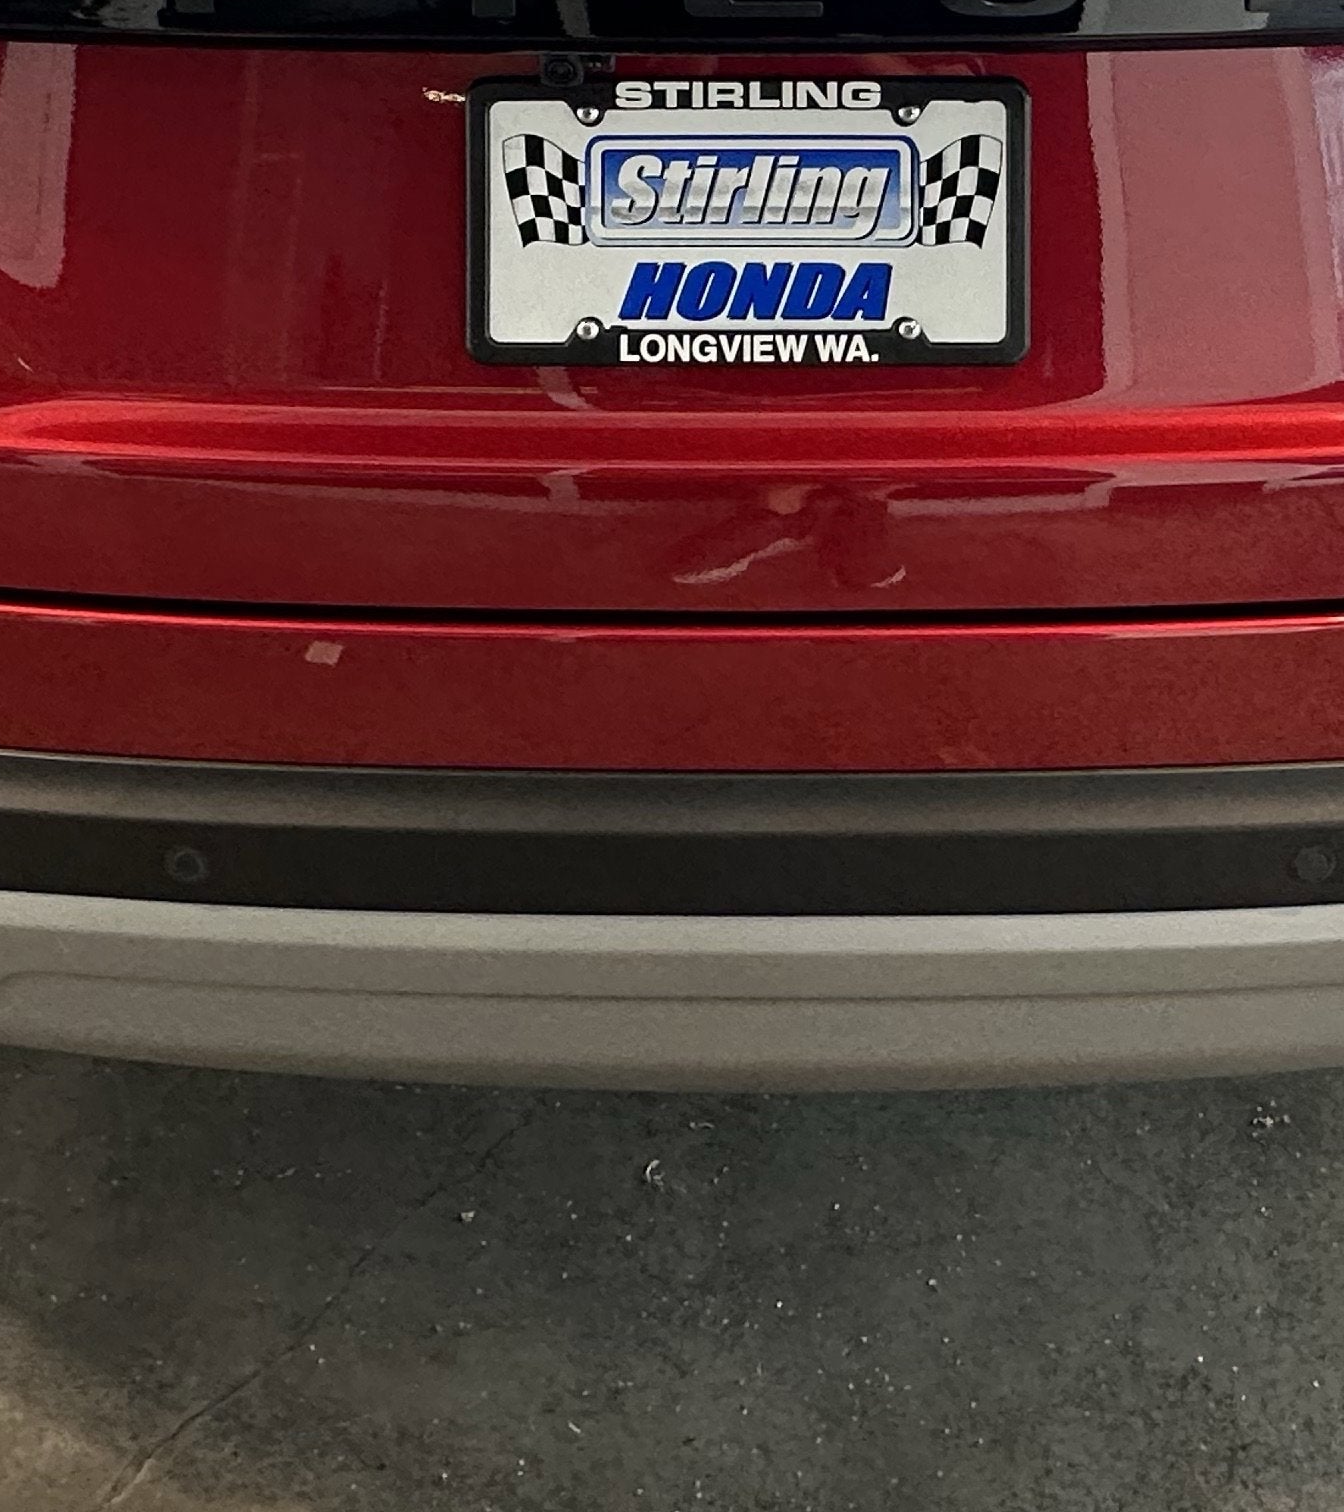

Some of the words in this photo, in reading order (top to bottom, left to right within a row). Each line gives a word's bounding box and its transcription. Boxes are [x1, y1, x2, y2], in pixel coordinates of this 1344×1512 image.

[614, 80, 882, 109] STIRLING
[610, 154, 891, 240] Stirling
[618, 261, 893, 321] HONDA
[619, 333, 807, 363] LONGVIEW
[814, 334, 880, 363] WA.
